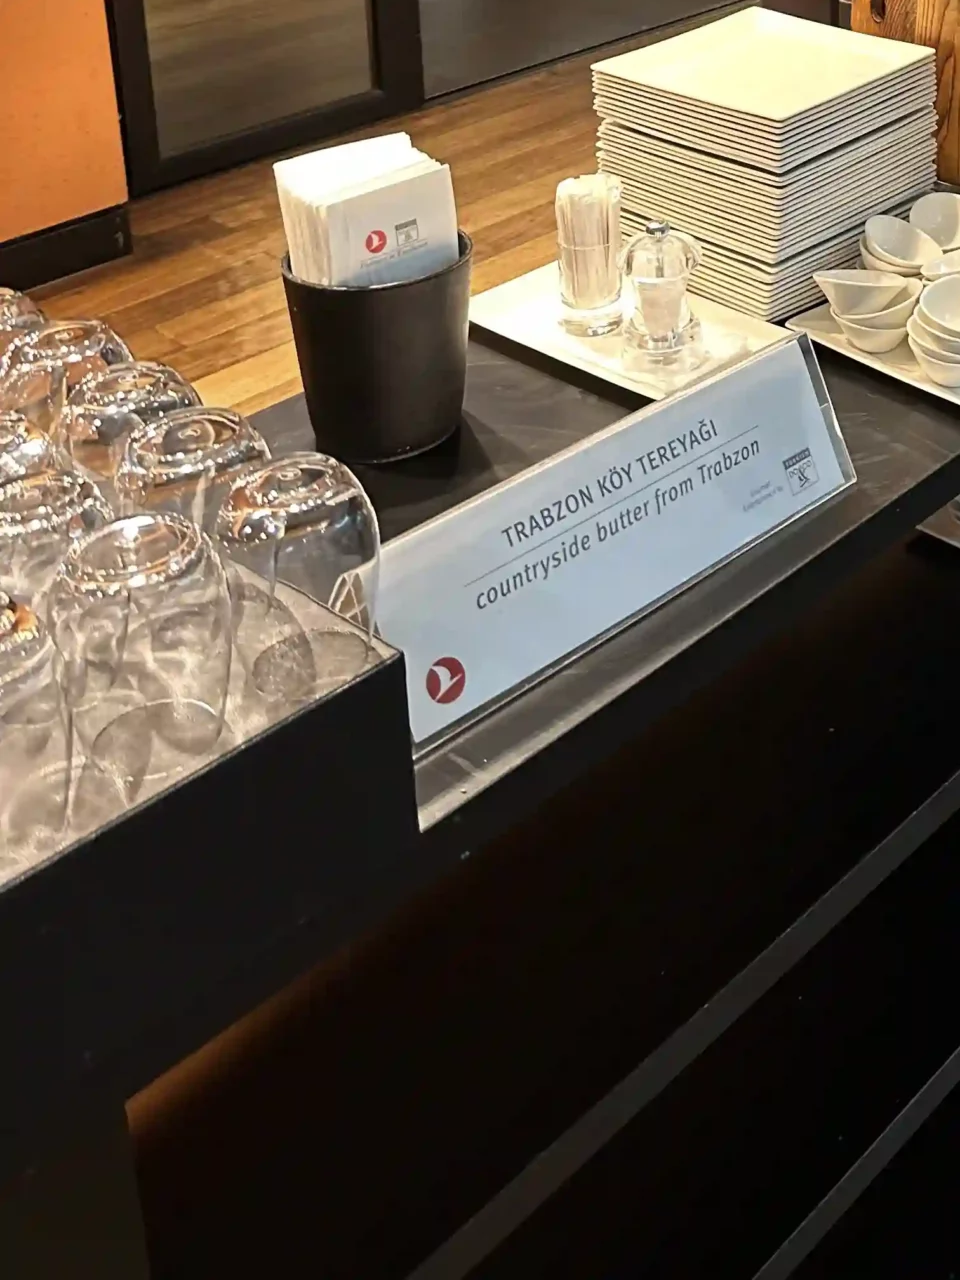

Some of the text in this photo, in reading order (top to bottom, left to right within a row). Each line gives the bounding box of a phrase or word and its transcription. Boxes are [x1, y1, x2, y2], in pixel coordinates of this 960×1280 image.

[476, 534, 591, 610] countryside
[596, 500, 650, 543] butter
[654, 476, 694, 515] from
[697, 440, 761, 485] Trabzon
[501, 419, 718, 548] TRABZON KÖY TEREYAĞI
